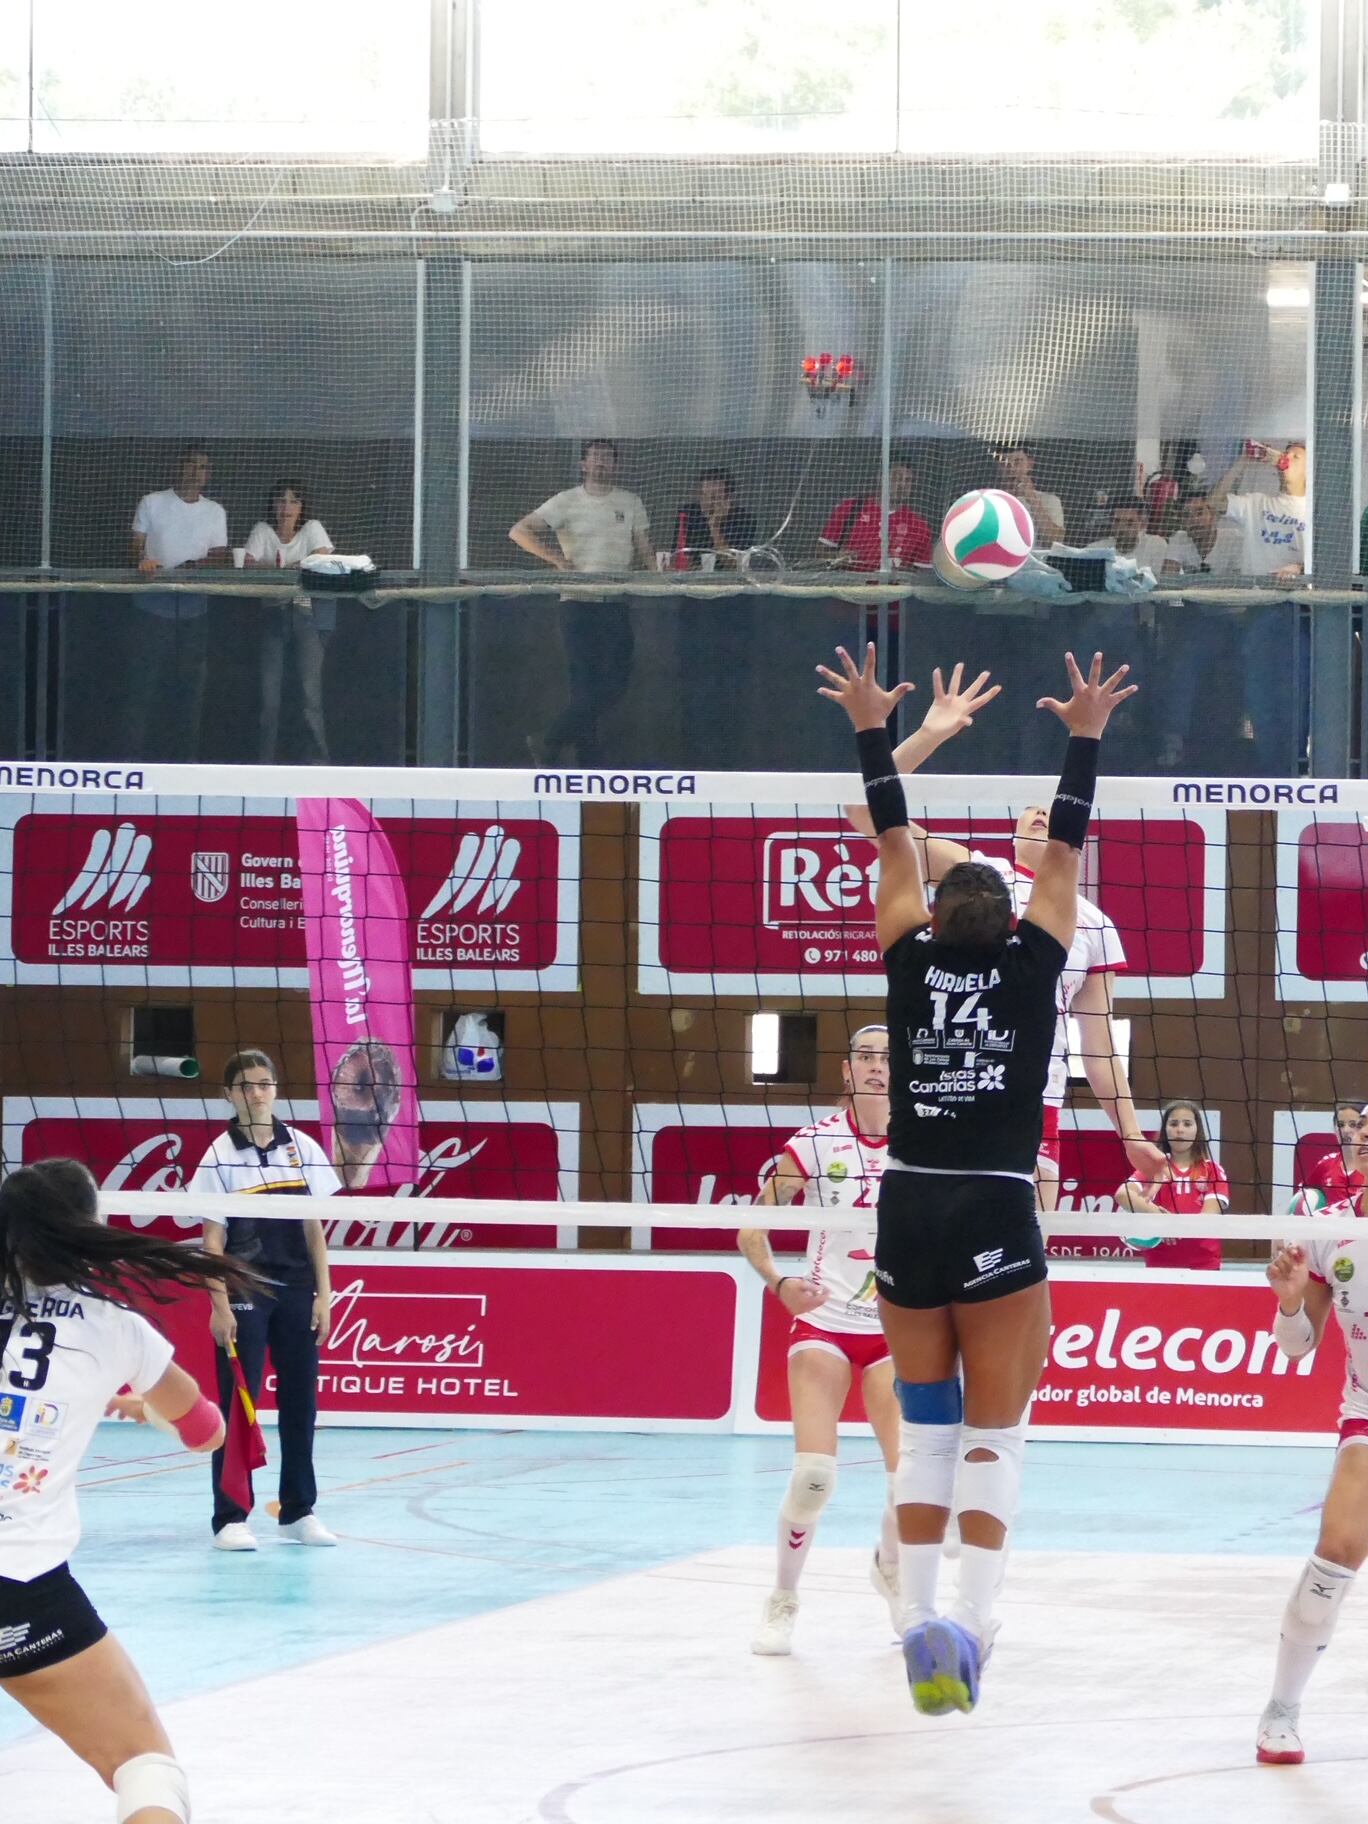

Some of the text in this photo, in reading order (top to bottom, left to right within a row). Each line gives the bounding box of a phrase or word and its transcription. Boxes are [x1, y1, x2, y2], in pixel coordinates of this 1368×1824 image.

[534, 774, 696, 795] MENORCA
[1173, 783, 1338, 804] MENORCA
[241, 853, 293, 868] Govern
[240, 873, 274, 889] Illes
[50, 919, 150, 941] ESPORTS
[240, 917, 286, 930] Cultura
[416, 923, 520, 945] ESPORTS
[87, 944, 149, 958] BALEARS
[416, 948, 520, 962] ILLES BALEARS
[852, 950, 878, 962] 480
[924, 965, 1002, 993] HIRUELA
[929, 991, 993, 1031] 14
[908, 1080, 976, 1094] Canarias
[417, 1377, 518, 1398] HOTEL
[1076, 1385, 1142, 1408] global
[1145, 1386, 1172, 1405] de
[1176, 1387, 1264, 1408] Menorca
